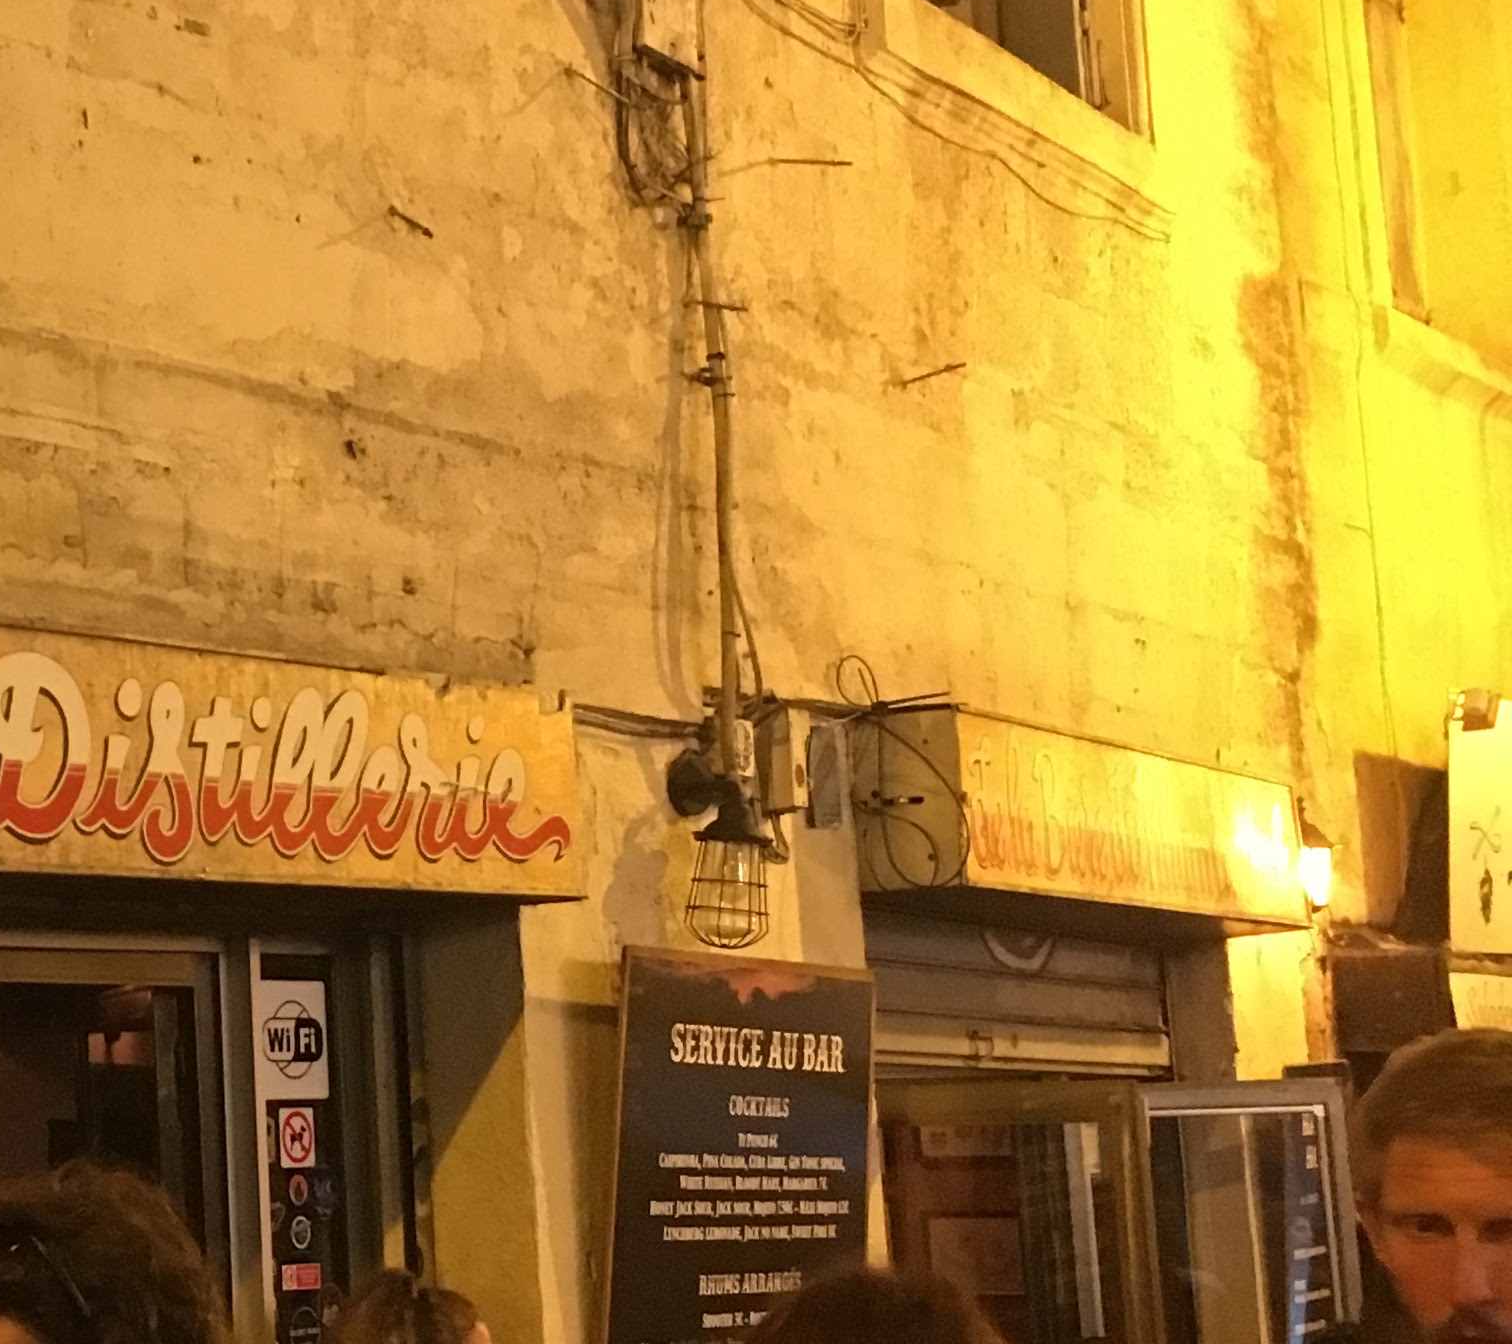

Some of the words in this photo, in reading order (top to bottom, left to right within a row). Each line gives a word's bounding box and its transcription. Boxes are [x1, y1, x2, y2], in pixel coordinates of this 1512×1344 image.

[670, 1022, 764, 1069] SERVICE
[767, 1030, 799, 1071] AU
[802, 1033, 847, 1074] BAR
[729, 1094, 790, 1118] COCKTAILS
[699, 1273, 741, 1296] RHUMS
